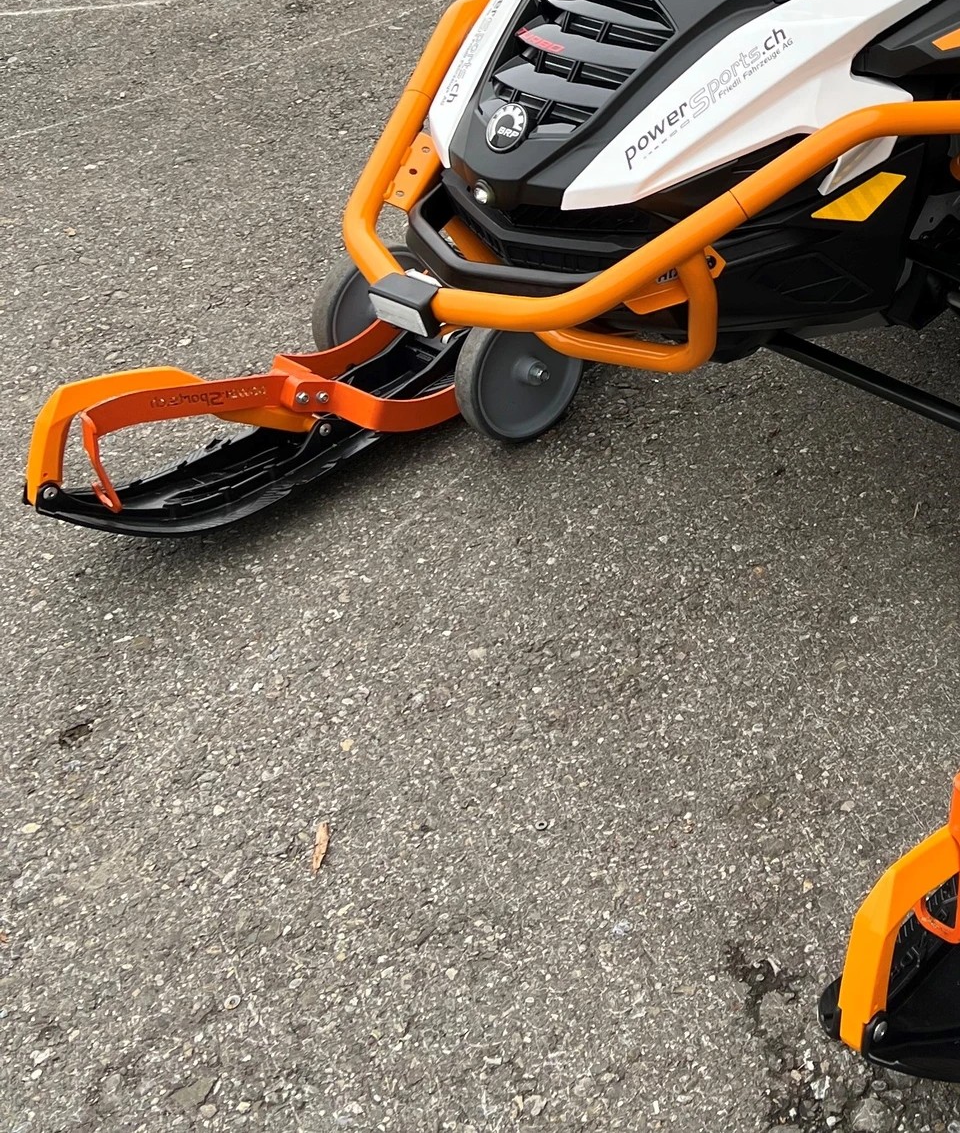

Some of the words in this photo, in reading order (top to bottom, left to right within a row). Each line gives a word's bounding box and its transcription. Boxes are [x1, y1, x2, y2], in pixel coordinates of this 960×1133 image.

[515, 26, 566, 54] TURBO
[742, 48, 781, 80] Fahrzeuge
[782, 37, 794, 51] AG
[497, 126, 520, 138] BRP
